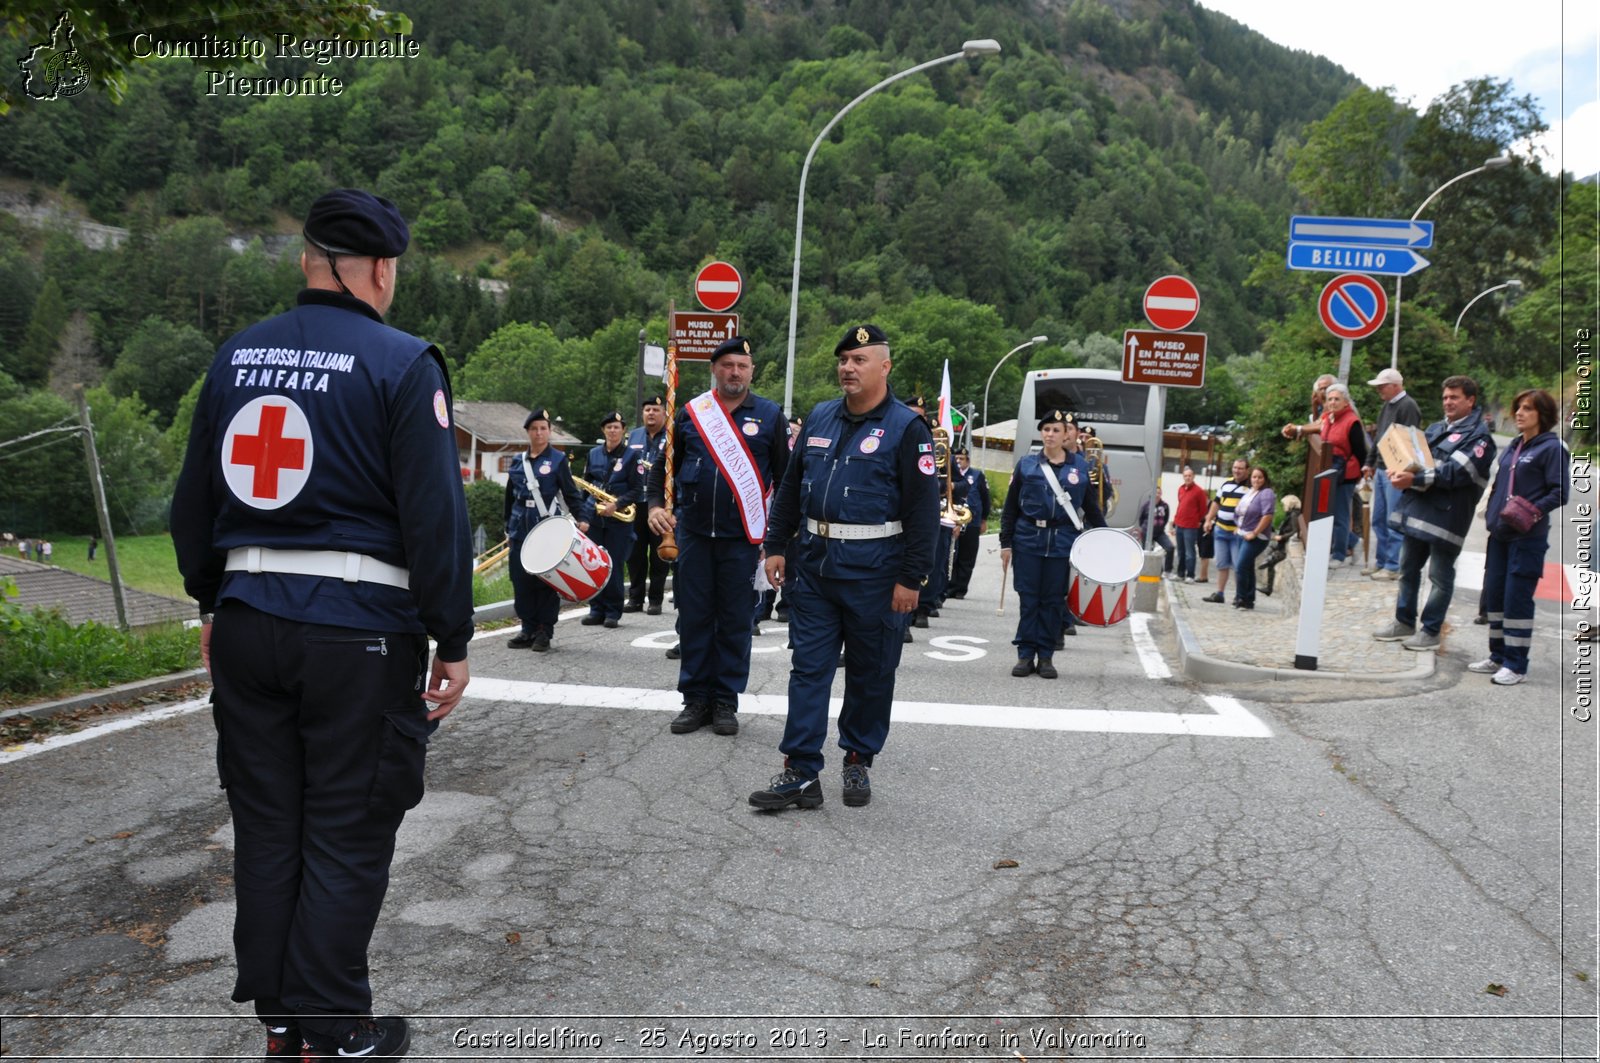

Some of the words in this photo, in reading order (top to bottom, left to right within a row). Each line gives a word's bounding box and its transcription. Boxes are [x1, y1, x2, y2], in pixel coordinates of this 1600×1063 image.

[1311, 248, 1386, 269] BELLINO
[687, 320, 714, 329] MUSEO
[675, 329, 687, 338] EN
[688, 330, 711, 338] PLEIN
[711, 331, 725, 339] AIR
[1152, 340, 1186, 351] MUSEO
[231, 348, 267, 366] CROCE
[263, 347, 301, 367] ROSSA
[300, 350, 355, 373] ITALIANA
[1138, 349, 1152, 359] EN
[1154, 350, 1181, 360] PLEIN
[1183, 352, 1200, 361] AIR
[1142, 368, 1193, 378] CASTELDELFINO
[234, 368, 330, 393] FANFARA
[706, 416, 734, 450] CROCE
[721, 443, 748, 481] ROSSA
[739, 475, 761, 525] ITALIANA
